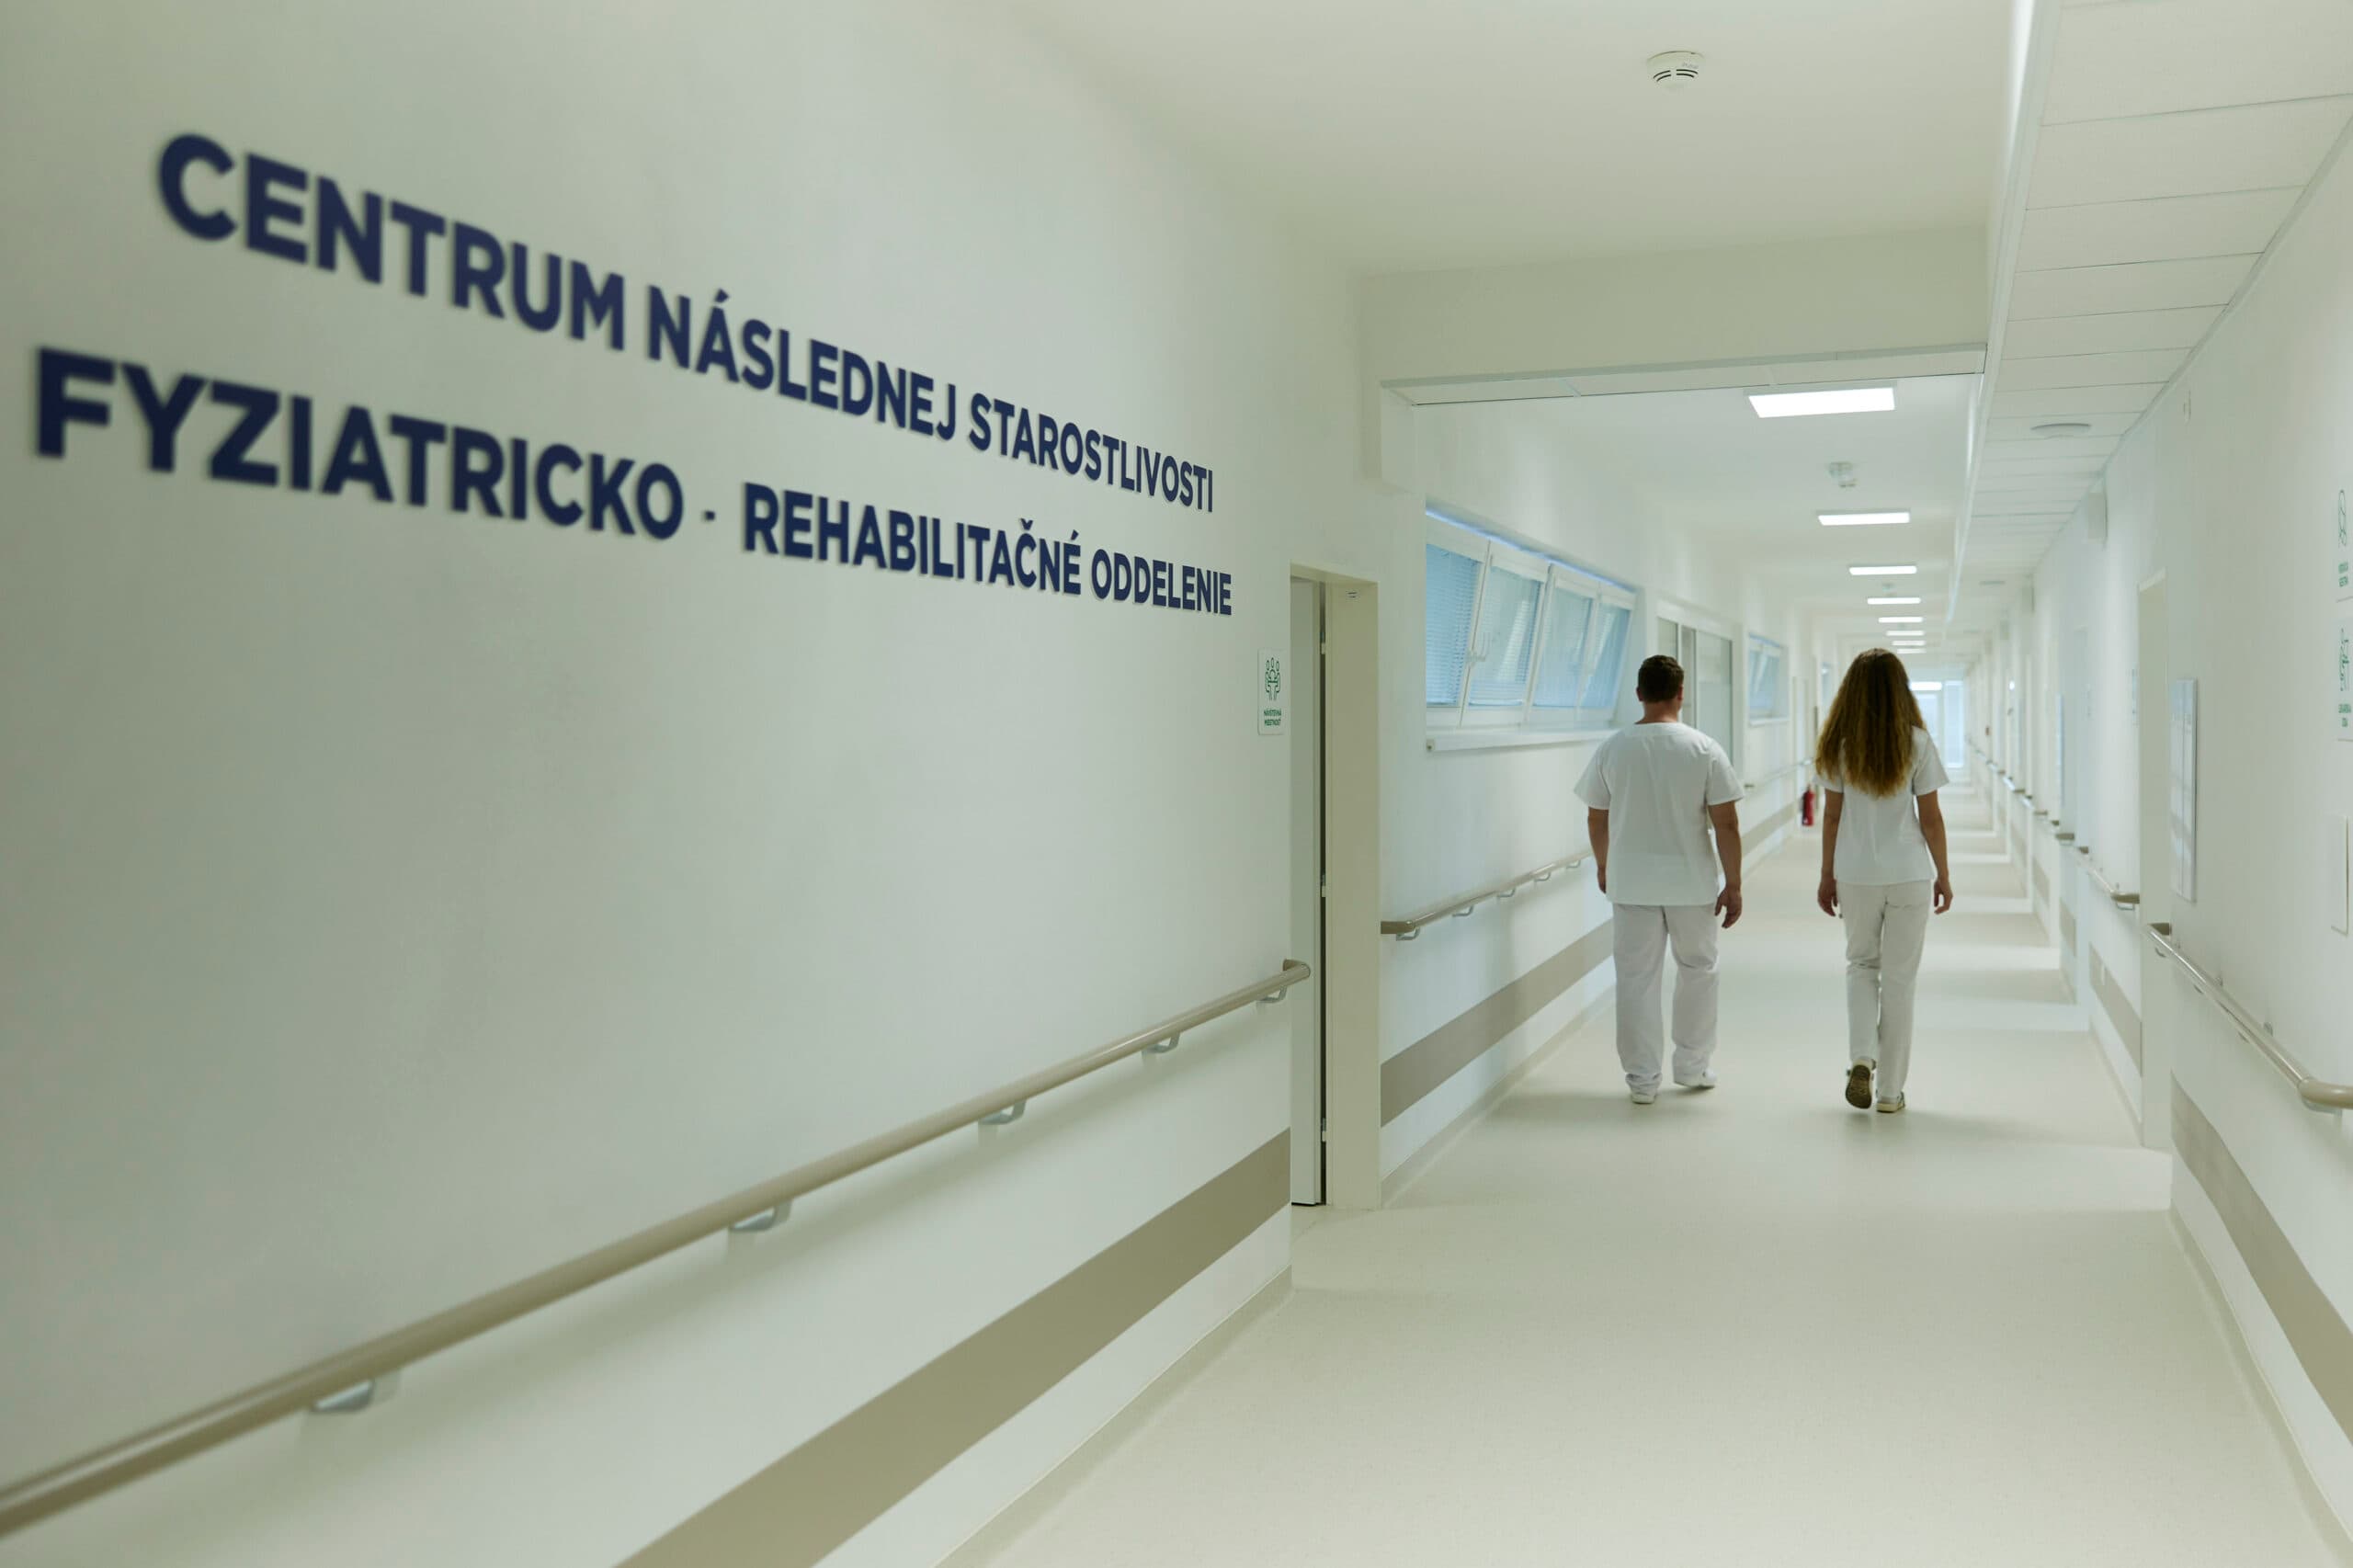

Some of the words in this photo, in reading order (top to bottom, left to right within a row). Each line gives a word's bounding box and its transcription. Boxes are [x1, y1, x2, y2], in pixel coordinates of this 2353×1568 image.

[36, 347, 684, 540] FYZIATRICKO
[743, 481, 1082, 597] REHABILITAČNÉ
[1090, 548, 1232, 616] ODDELENIE
[157, 132, 625, 352] CENTRUM
[647, 285, 957, 442] NÁSLEDNEJ
[968, 392, 1213, 513] STAROSTLIVOSTI
